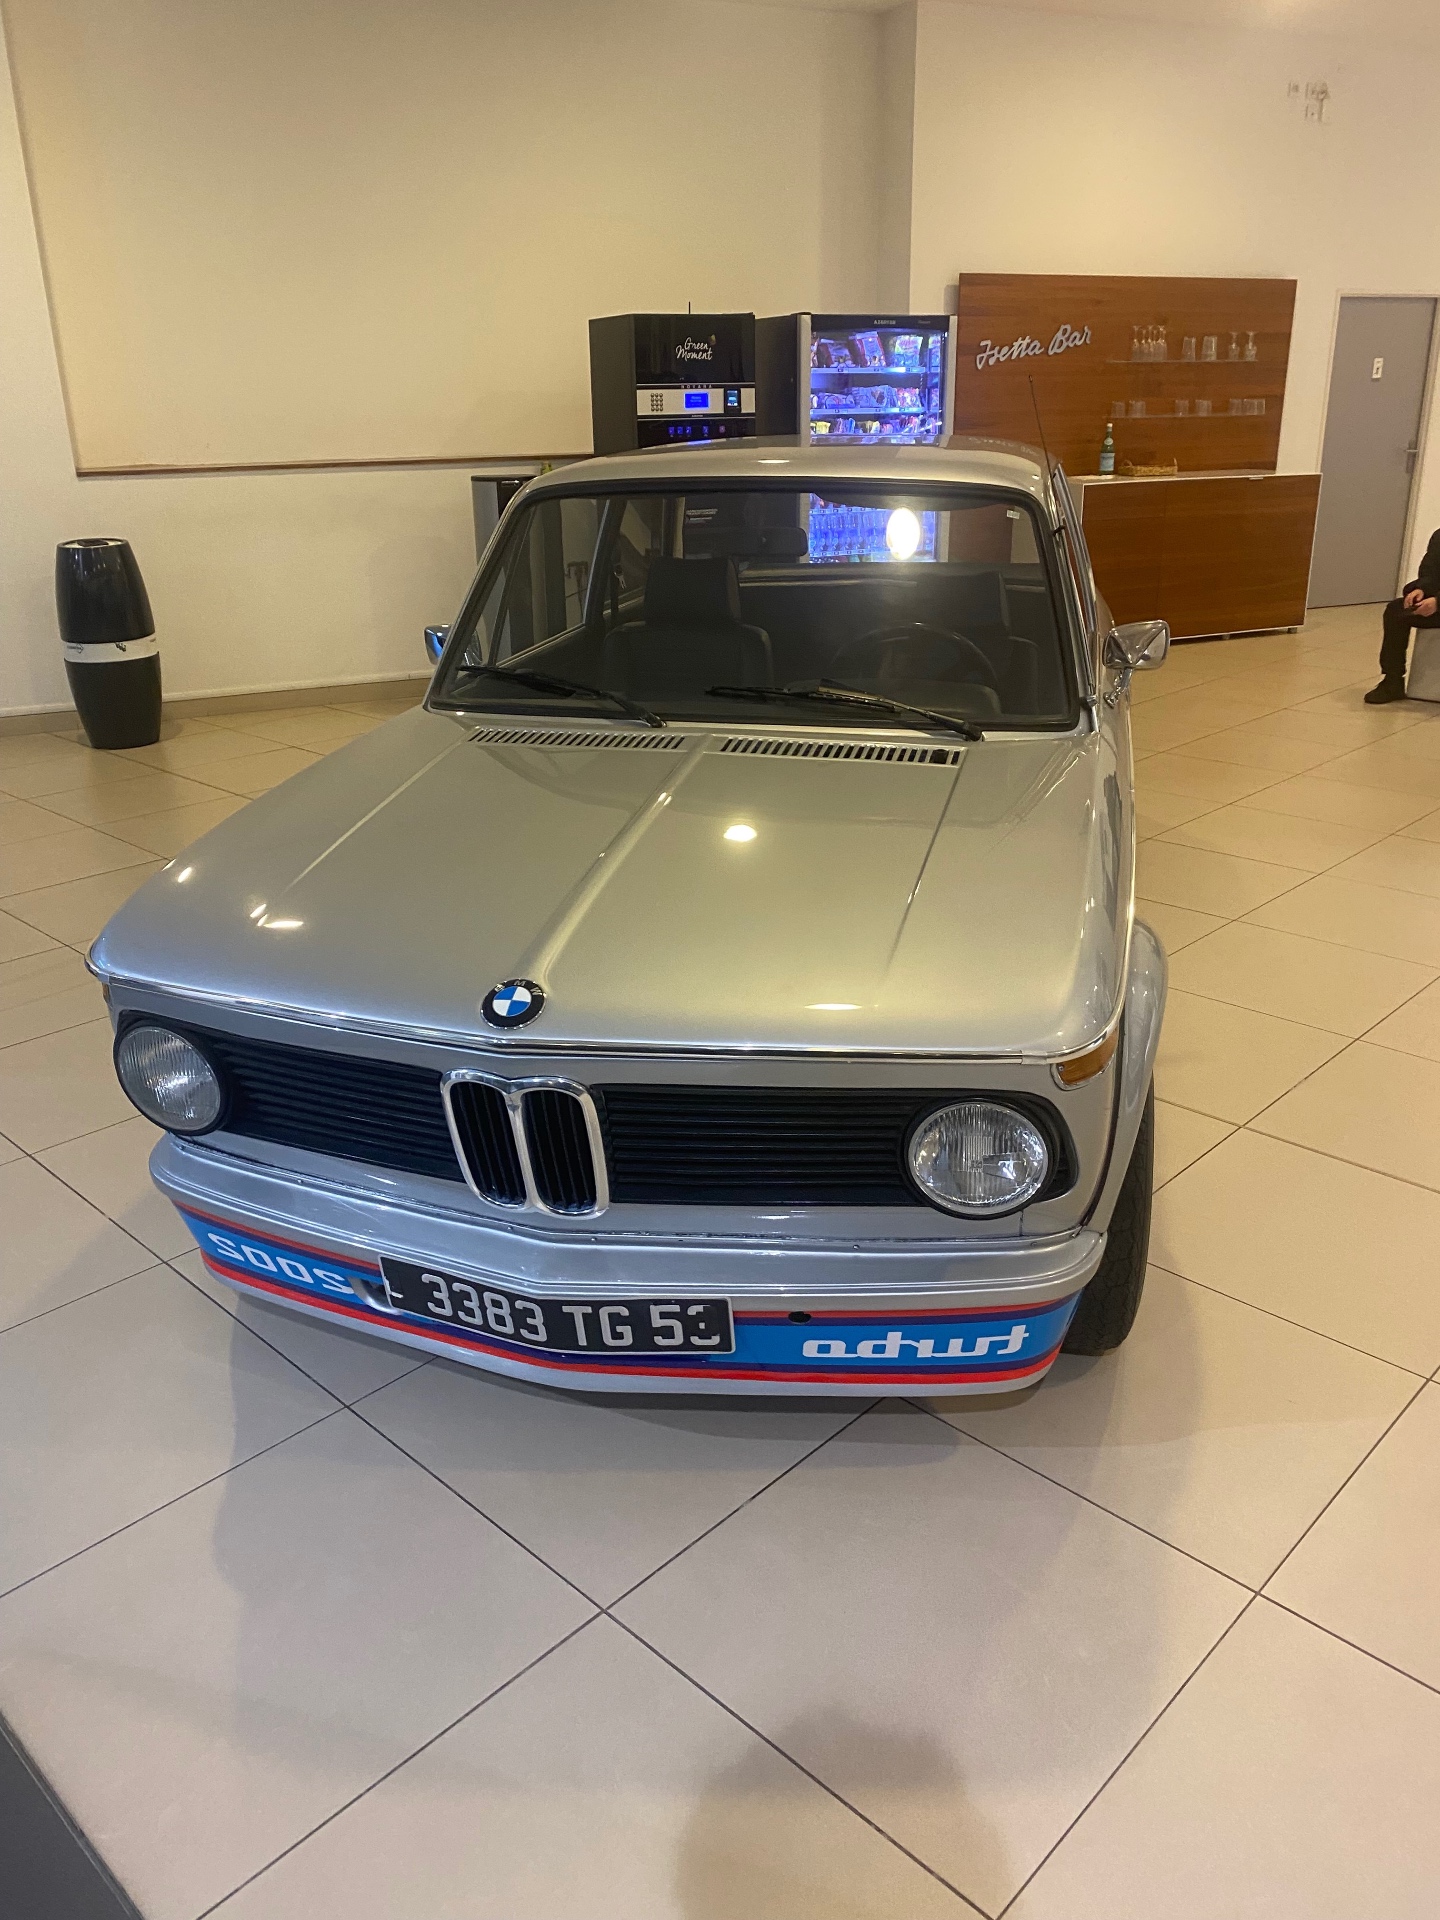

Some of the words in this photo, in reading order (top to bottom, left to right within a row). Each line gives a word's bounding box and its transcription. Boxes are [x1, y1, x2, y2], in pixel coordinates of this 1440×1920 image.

[684, 337, 708, 350] Green
[975, 336, 1044, 370] Isetta
[1048, 324, 1091, 355] Bar
[675, 345, 713, 361] Moment
[494, 980, 542, 996] BMW
[421, 1273, 547, 1342] 3383
[561, 1305, 633, 1347] TG
